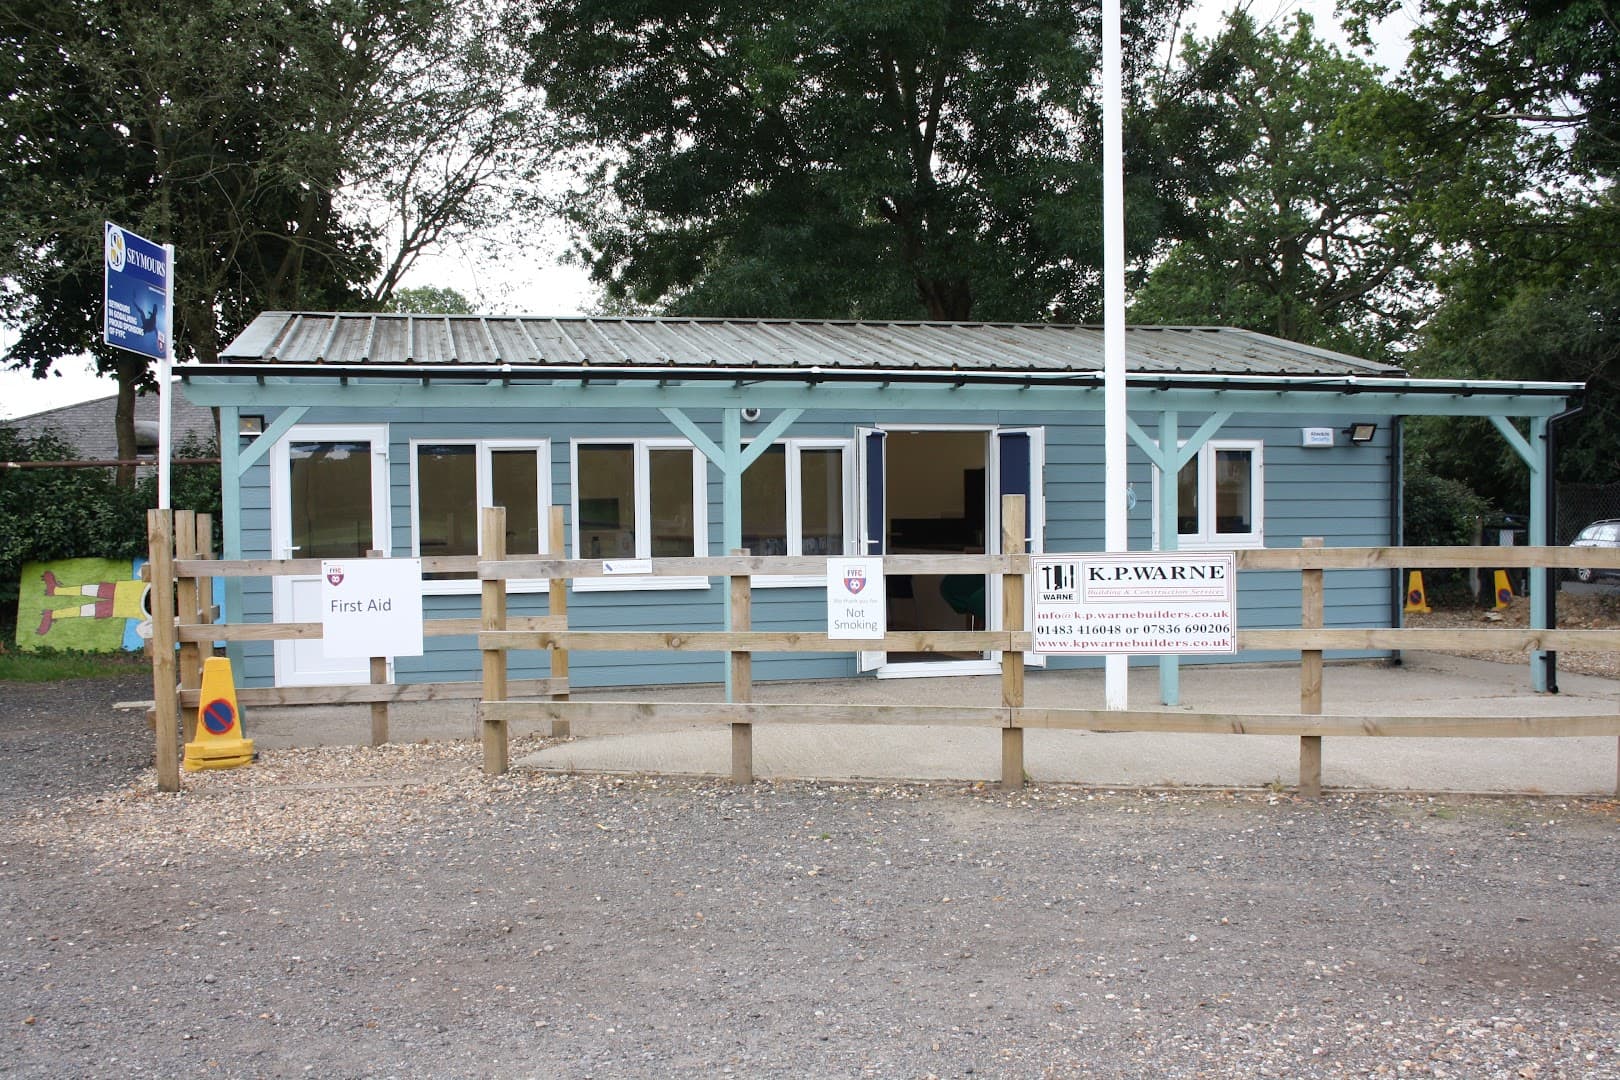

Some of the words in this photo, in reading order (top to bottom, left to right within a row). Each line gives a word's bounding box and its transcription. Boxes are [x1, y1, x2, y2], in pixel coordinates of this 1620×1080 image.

[126, 247, 165, 277] SEYMOURS
[109, 317, 122, 329] PROUD
[1089, 565, 1225, 581] K.P.WARNE
[1043, 593, 1074, 601] WARNE
[330, 600, 363, 613] First
[367, 598, 392, 612] Aid
[846, 608, 865, 618] Not
[834, 619, 878, 632] Smoking
[1037, 625, 1073, 635] 01483
[1077, 624, 1121, 634] 416048
[1143, 624, 1180, 633] 07836
[1185, 623, 1230, 633] 690206
[1037, 638, 1230, 648] www.kpwarnebuilders.co.uk
